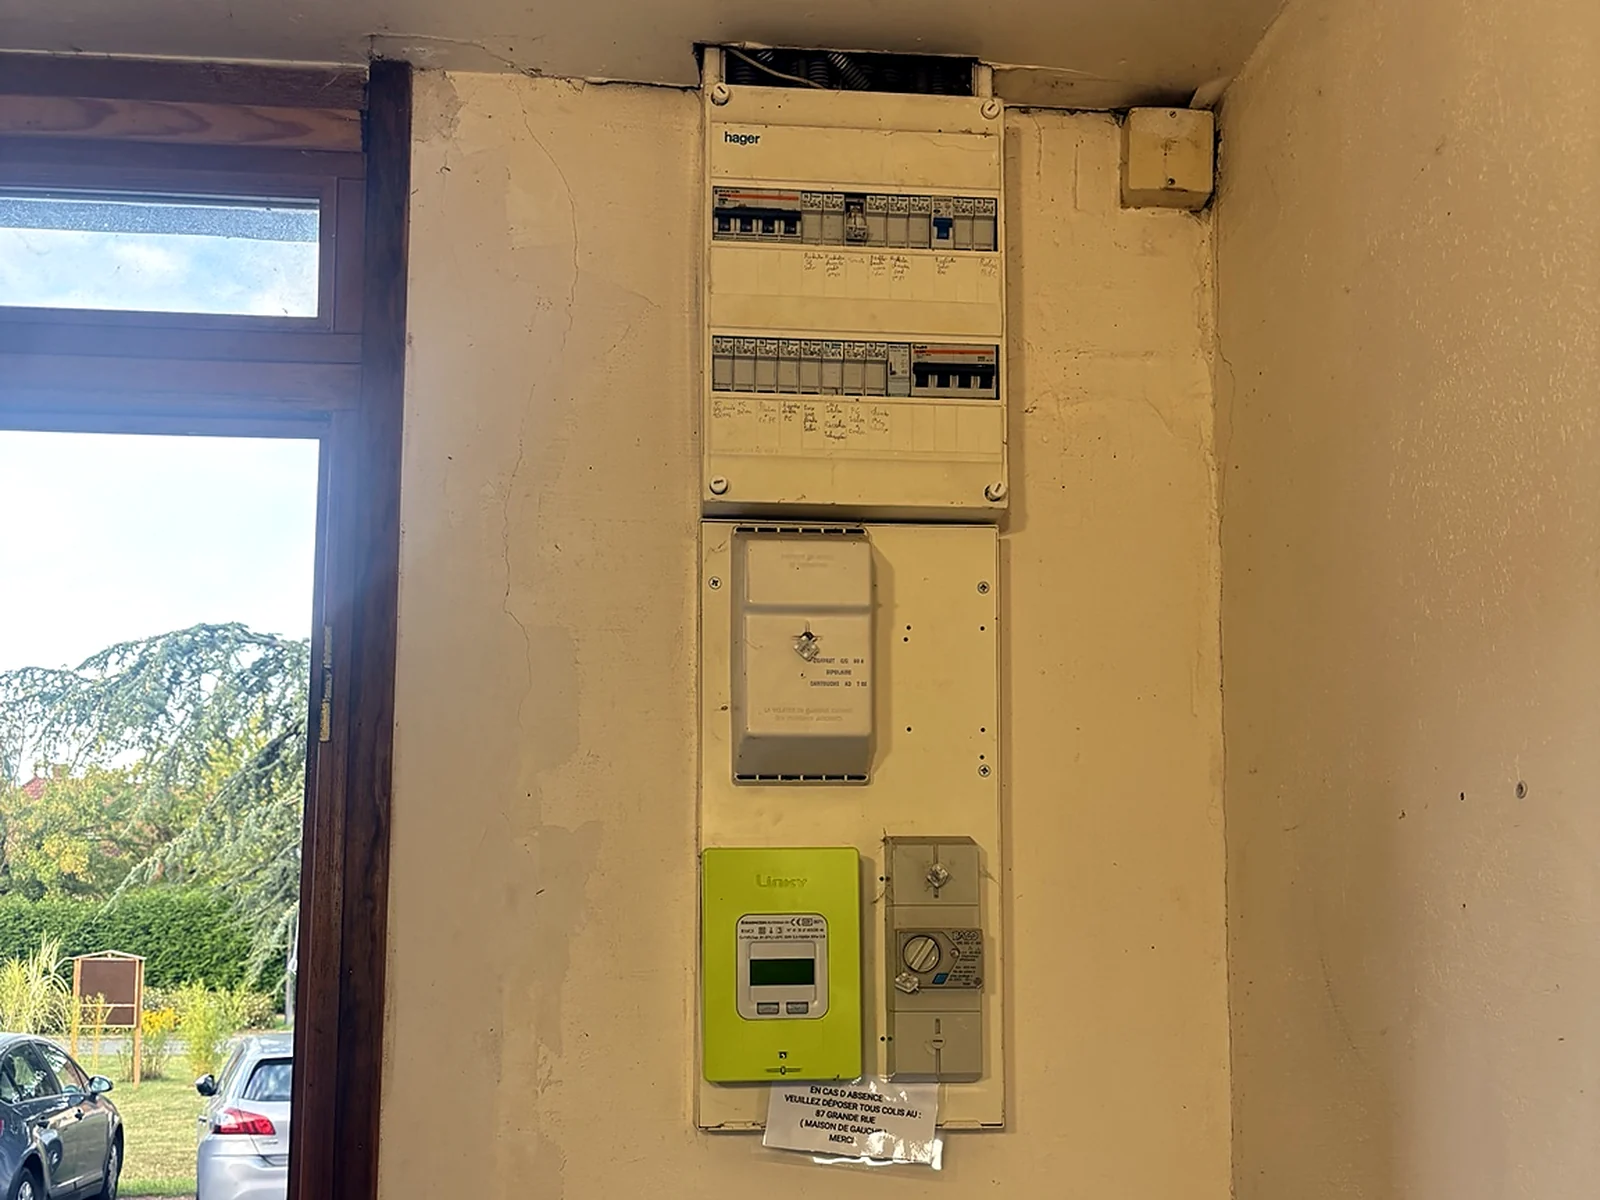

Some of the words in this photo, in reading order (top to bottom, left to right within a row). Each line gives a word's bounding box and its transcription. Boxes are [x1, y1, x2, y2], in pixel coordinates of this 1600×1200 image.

[724, 131, 760, 145] hager
[810, 1086, 822, 1094] EN
[822, 1087, 839, 1097] CAS
[847, 1090, 884, 1102] ABSENCE
[784, 1094, 821, 1106] VEUILLEZ
[821, 1098, 858, 1111] DÉPOSER
[859, 1104, 881, 1114] TOUS
[882, 1106, 905, 1117] COLIS
[906, 1109, 917, 1118] AU
[815, 1109, 825, 1118] 87
[827, 1110, 859, 1123] GRANDE
[860, 1114, 876, 1124] RUE
[804, 1119, 837, 1131] MAISON
[838, 1123, 849, 1132] DE
[829, 1134, 855, 1144] MERCI
